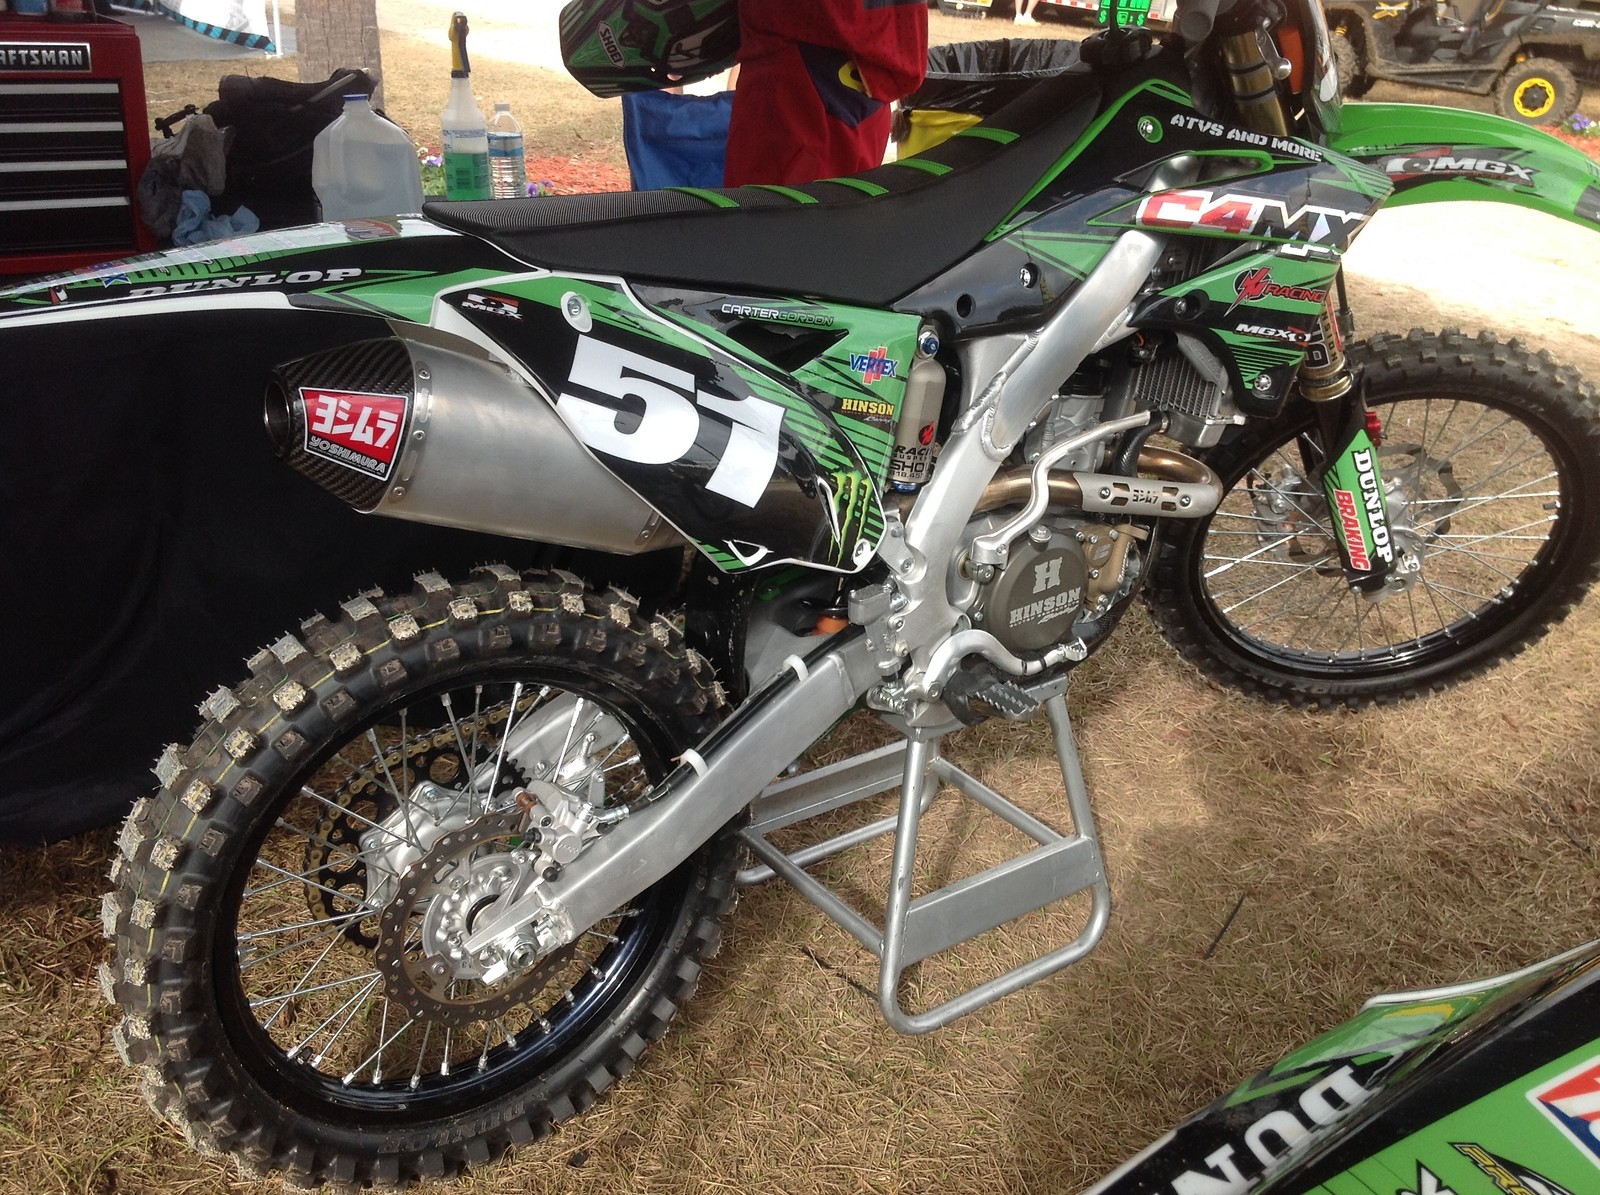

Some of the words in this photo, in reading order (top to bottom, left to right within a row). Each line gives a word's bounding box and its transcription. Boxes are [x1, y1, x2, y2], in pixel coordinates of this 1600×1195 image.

[600, 27, 623, 63] SHOEI
[1170, 113, 1225, 137] ATVS
[1226, 128, 1269, 146] AND
[1271, 137, 1324, 163] MORE
[1434, 156, 1534, 181] MGX
[129, 267, 362, 298] DUNLOP
[1264, 283, 1326, 303] RACING
[850, 353, 900, 378] VERTEX
[311, 394, 399, 449] ヨシムラ
[841, 398, 895, 416] HINSON
[309, 435, 387, 474] YOSHIMURA
[1352, 447, 1394, 564] DUNLOP
[1333, 488, 1372, 571] BRAKING
[1032, 556, 1063, 594] H
[1009, 586, 1081, 625] HINSON
